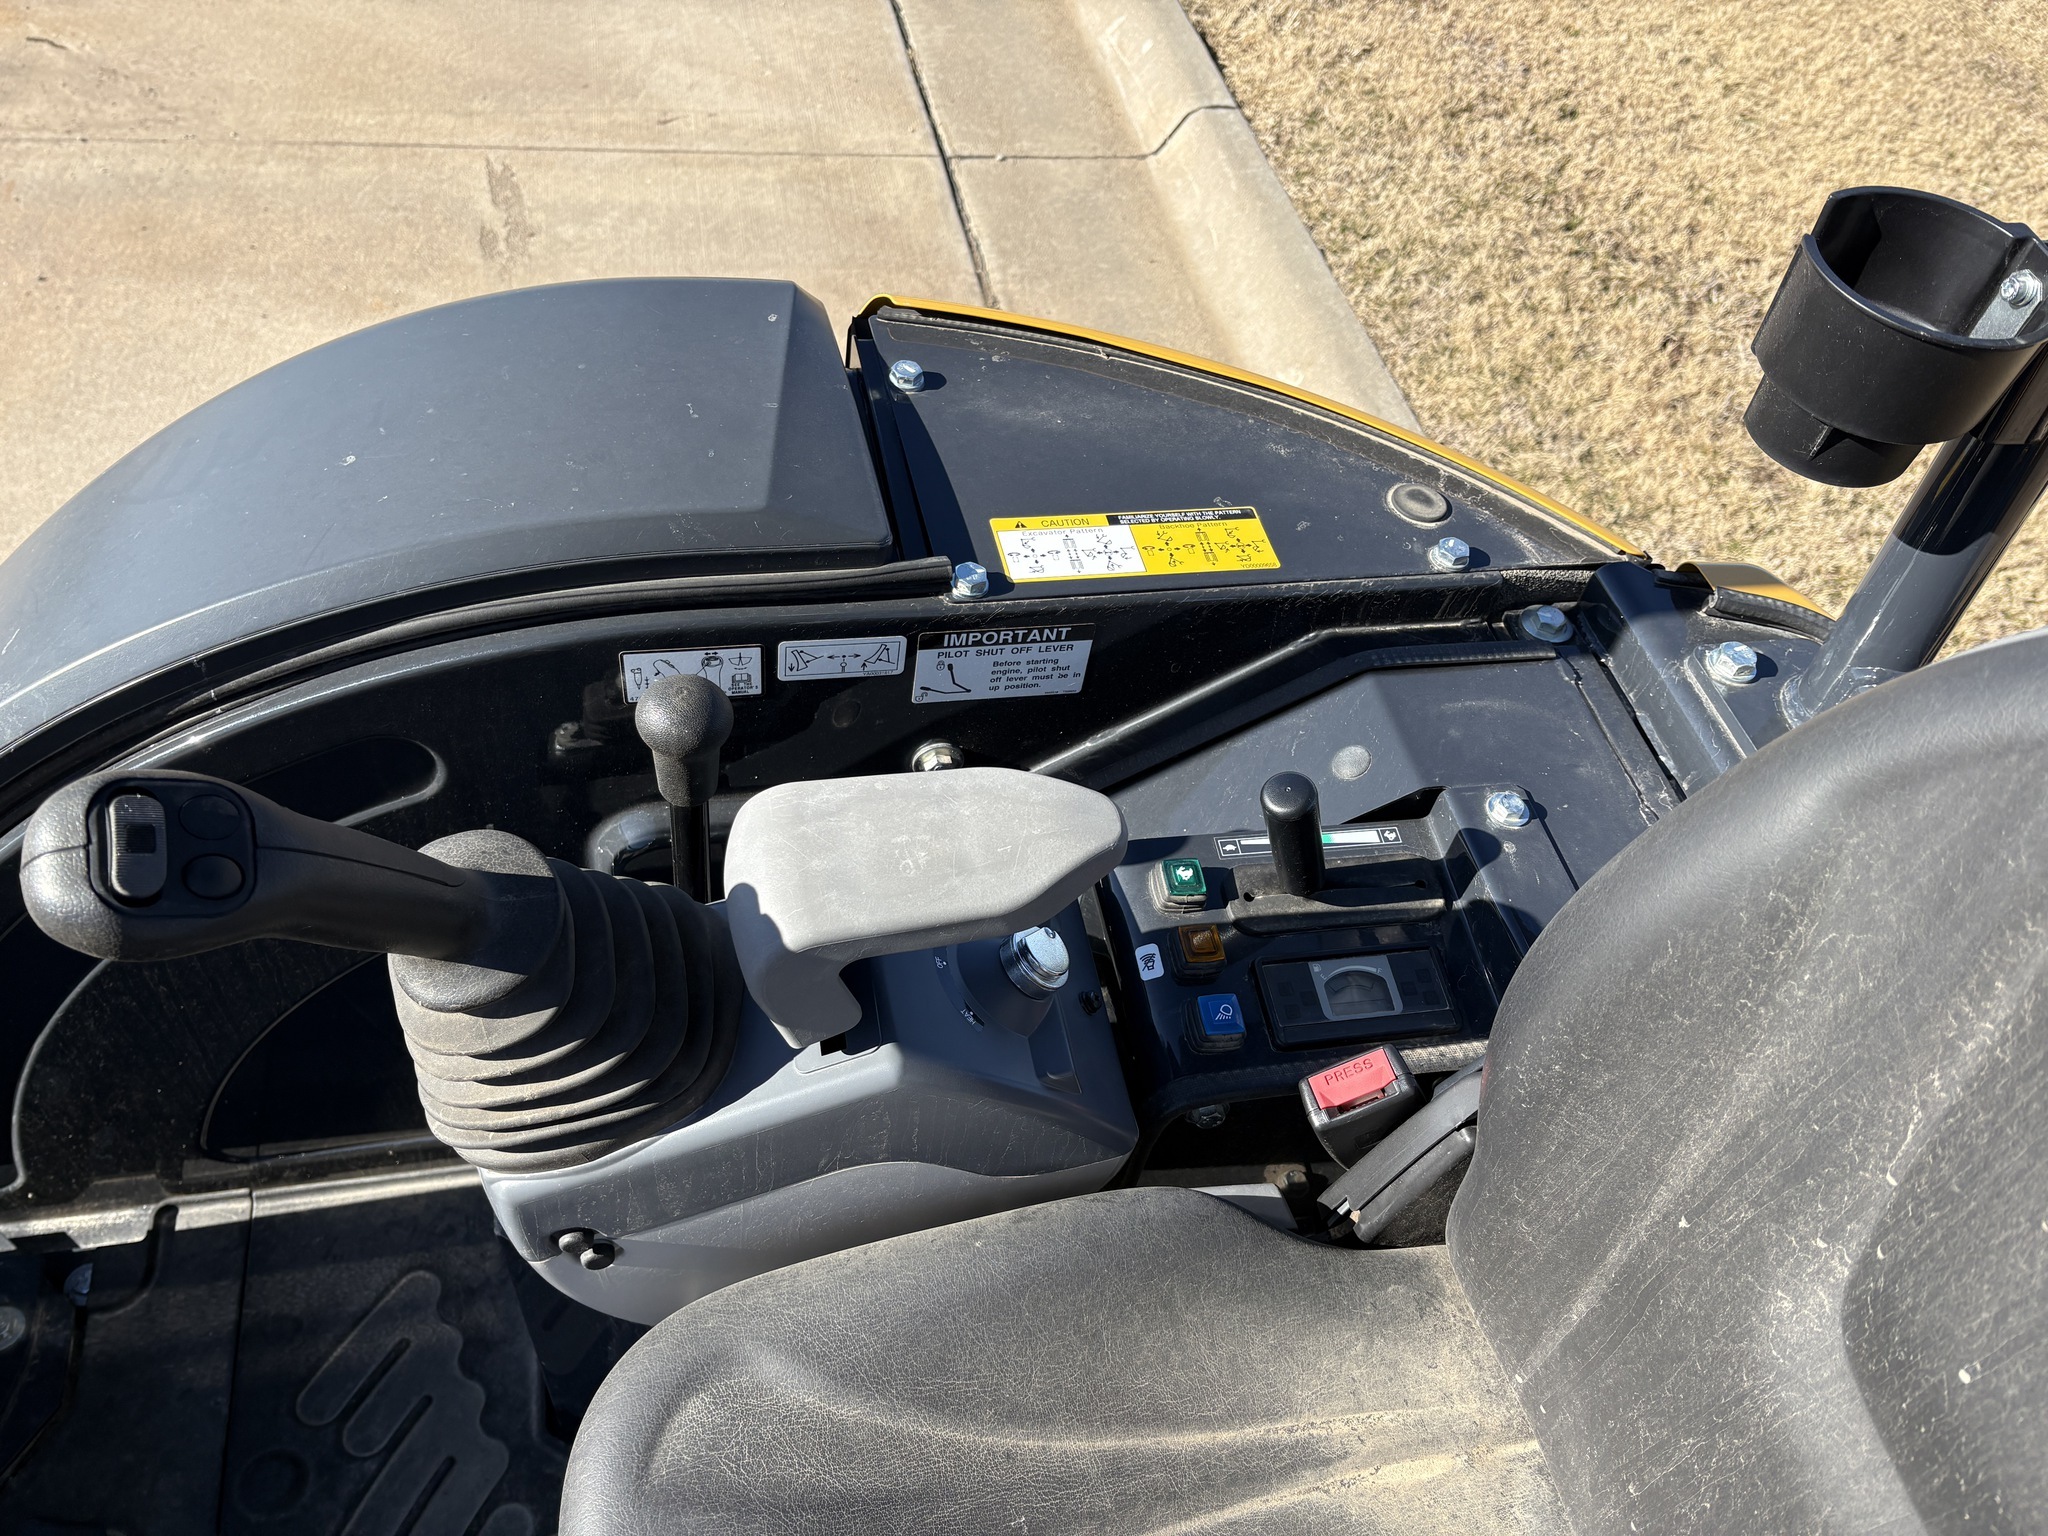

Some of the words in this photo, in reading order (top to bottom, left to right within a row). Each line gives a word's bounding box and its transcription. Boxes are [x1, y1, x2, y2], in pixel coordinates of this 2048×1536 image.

[1041, 518, 1090, 528] CAUTION
[943, 627, 1072, 647] IMPORTANT
[937, 650, 970, 659] PILOT
[975, 648, 1006, 657] SHUT
[1011, 646, 1033, 655] OFF
[1038, 644, 1074, 653] LEVER
[992, 660, 1022, 668] Before
[991, 668, 1023, 676] engine,
[1027, 666, 1047, 674] pilot
[1004, 683, 1041, 691] position.
[960, 1008, 977, 1025] HEAT
[1324, 1058, 1374, 1086] PRESS
